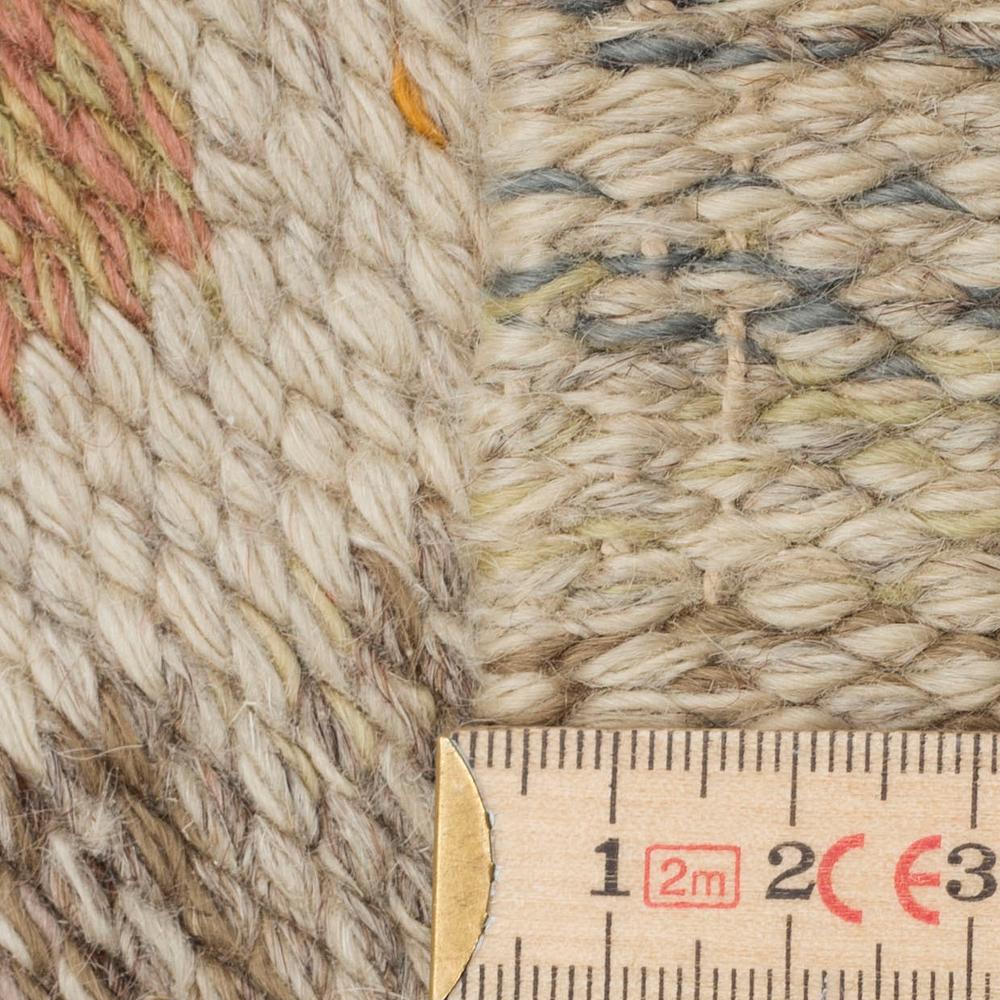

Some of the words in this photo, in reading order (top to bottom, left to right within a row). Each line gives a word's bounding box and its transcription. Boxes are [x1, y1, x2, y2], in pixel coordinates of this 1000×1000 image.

[590, 838, 631, 897] 1
[659, 857, 727, 897] 2m
[765, 840, 816, 900] 2
[817, 832, 942, 925] CE
[945, 842, 998, 903] 3
